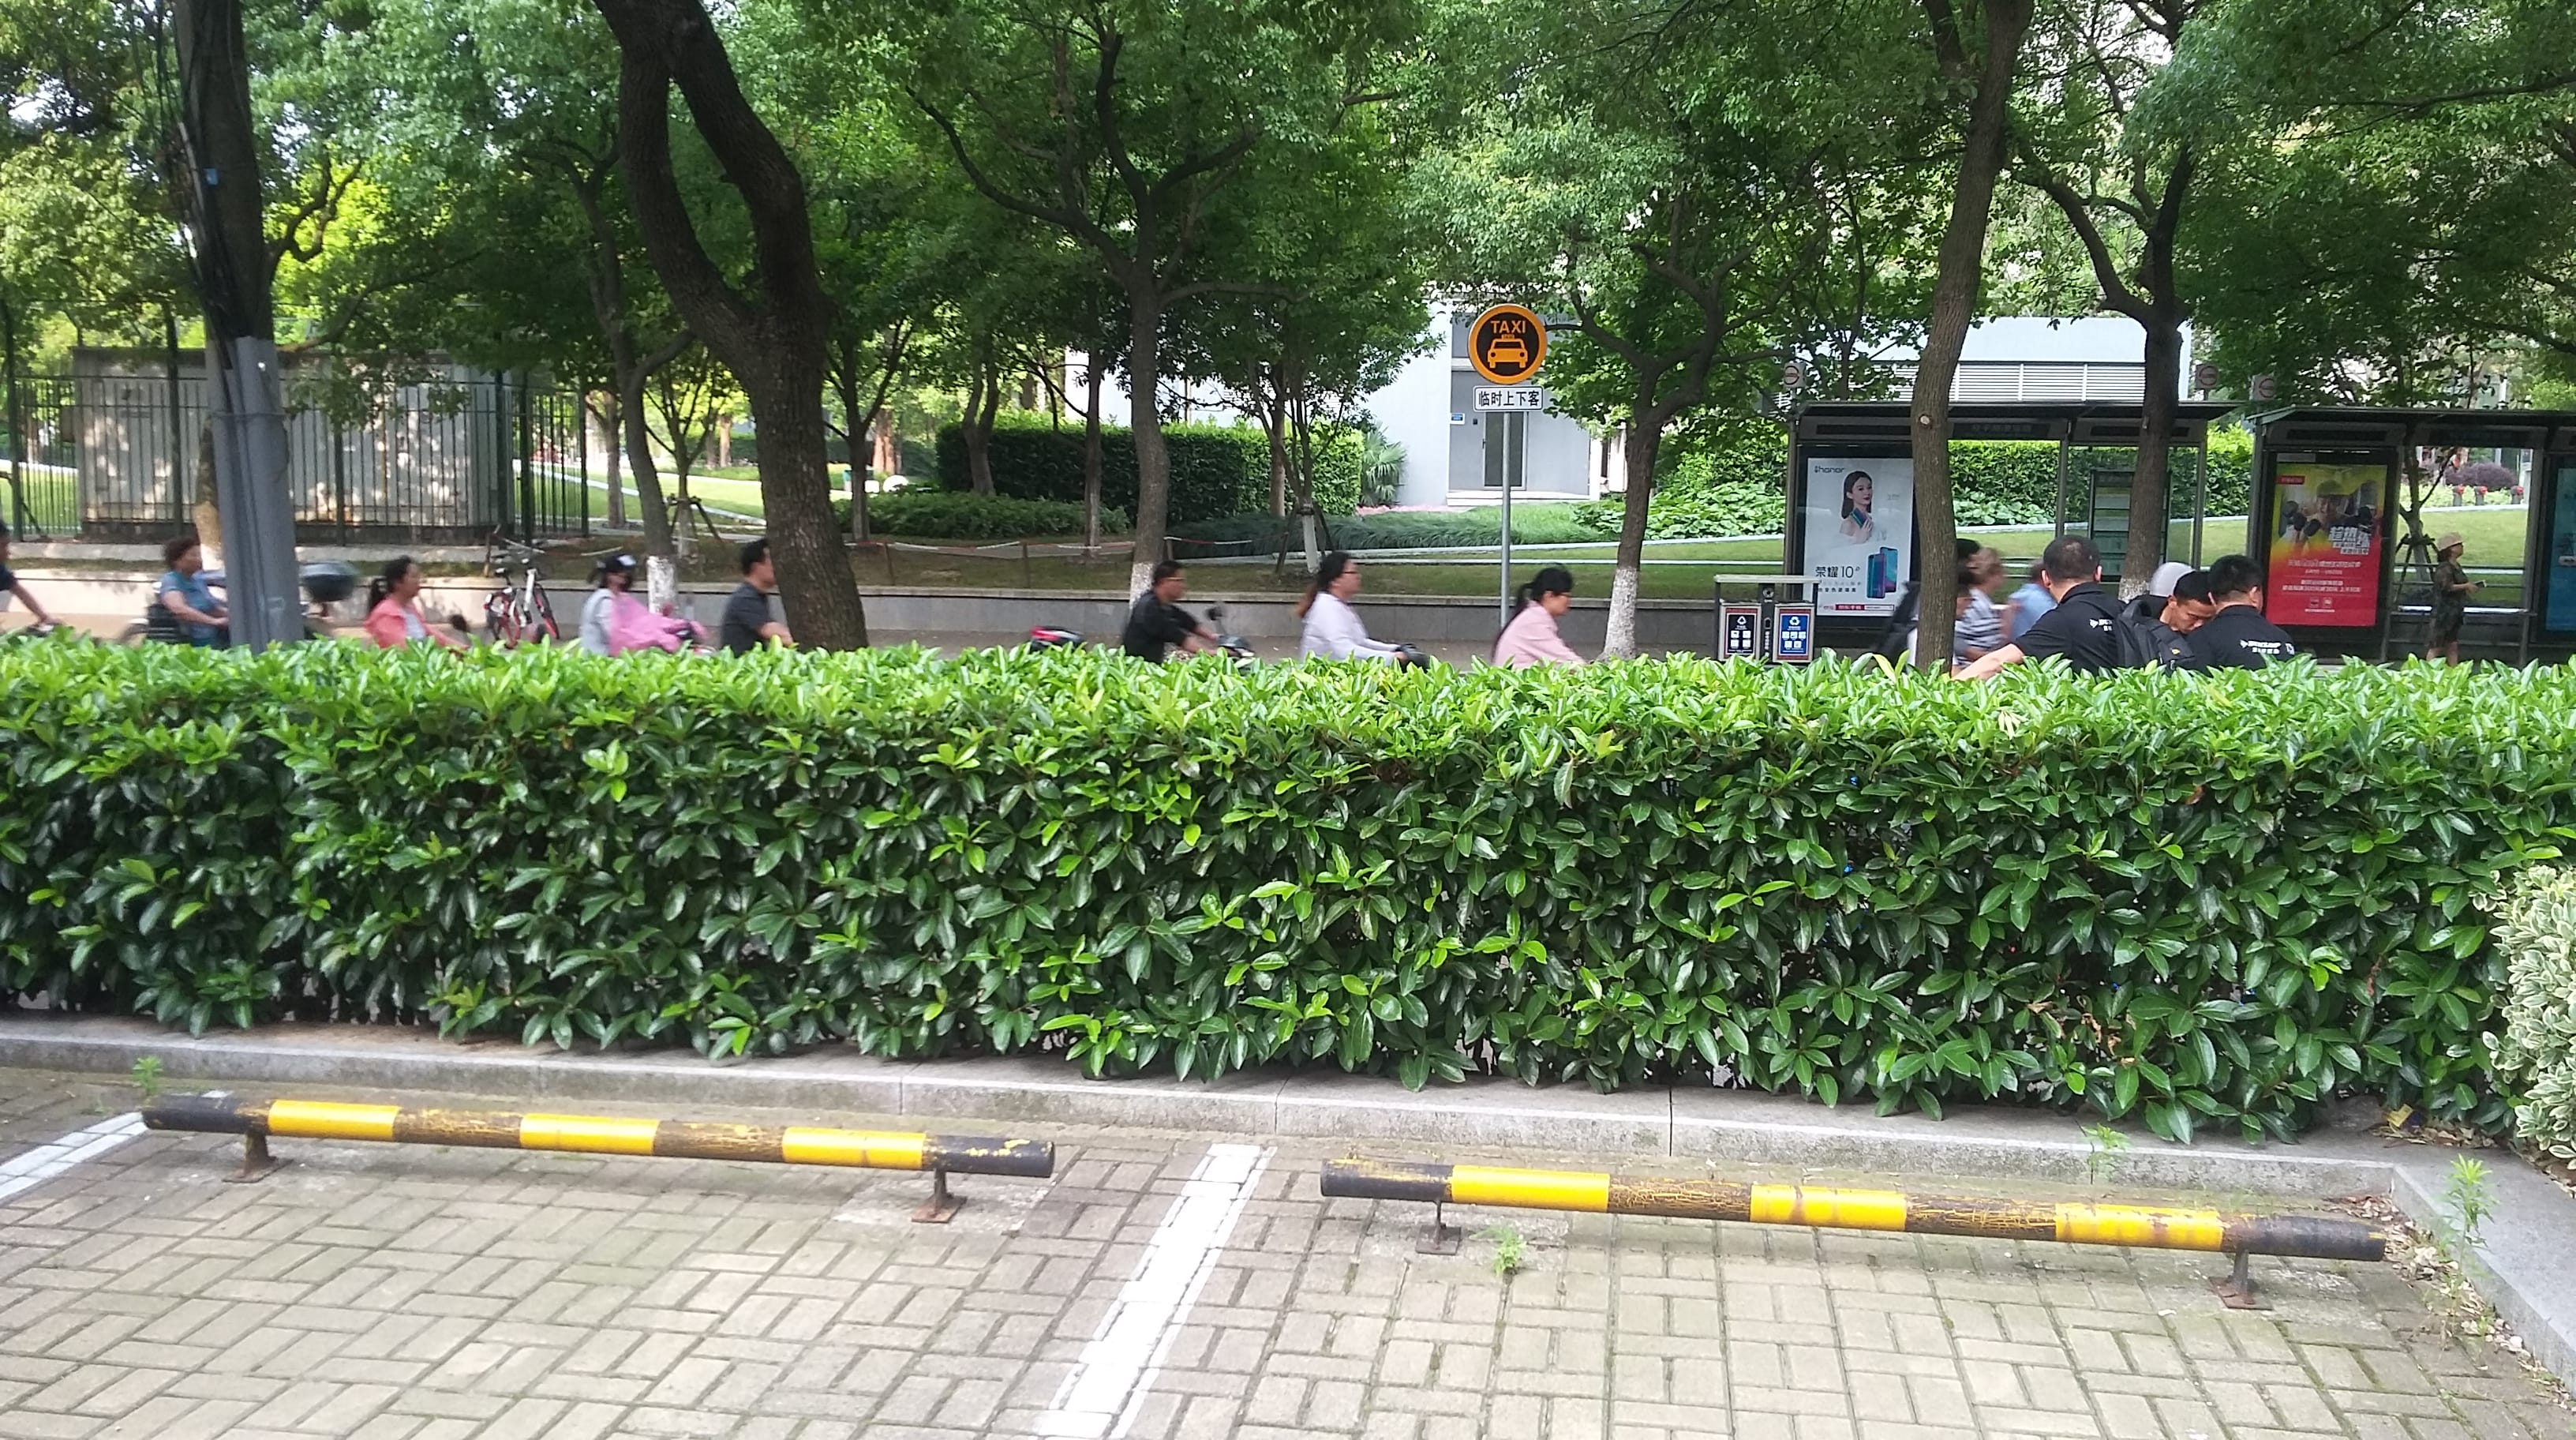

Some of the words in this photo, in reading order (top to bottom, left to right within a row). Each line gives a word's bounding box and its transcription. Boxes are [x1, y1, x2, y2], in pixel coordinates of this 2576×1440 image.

[1491, 321, 1526, 334] TAXI
[1479, 390, 1539, 407] 临时上下客
